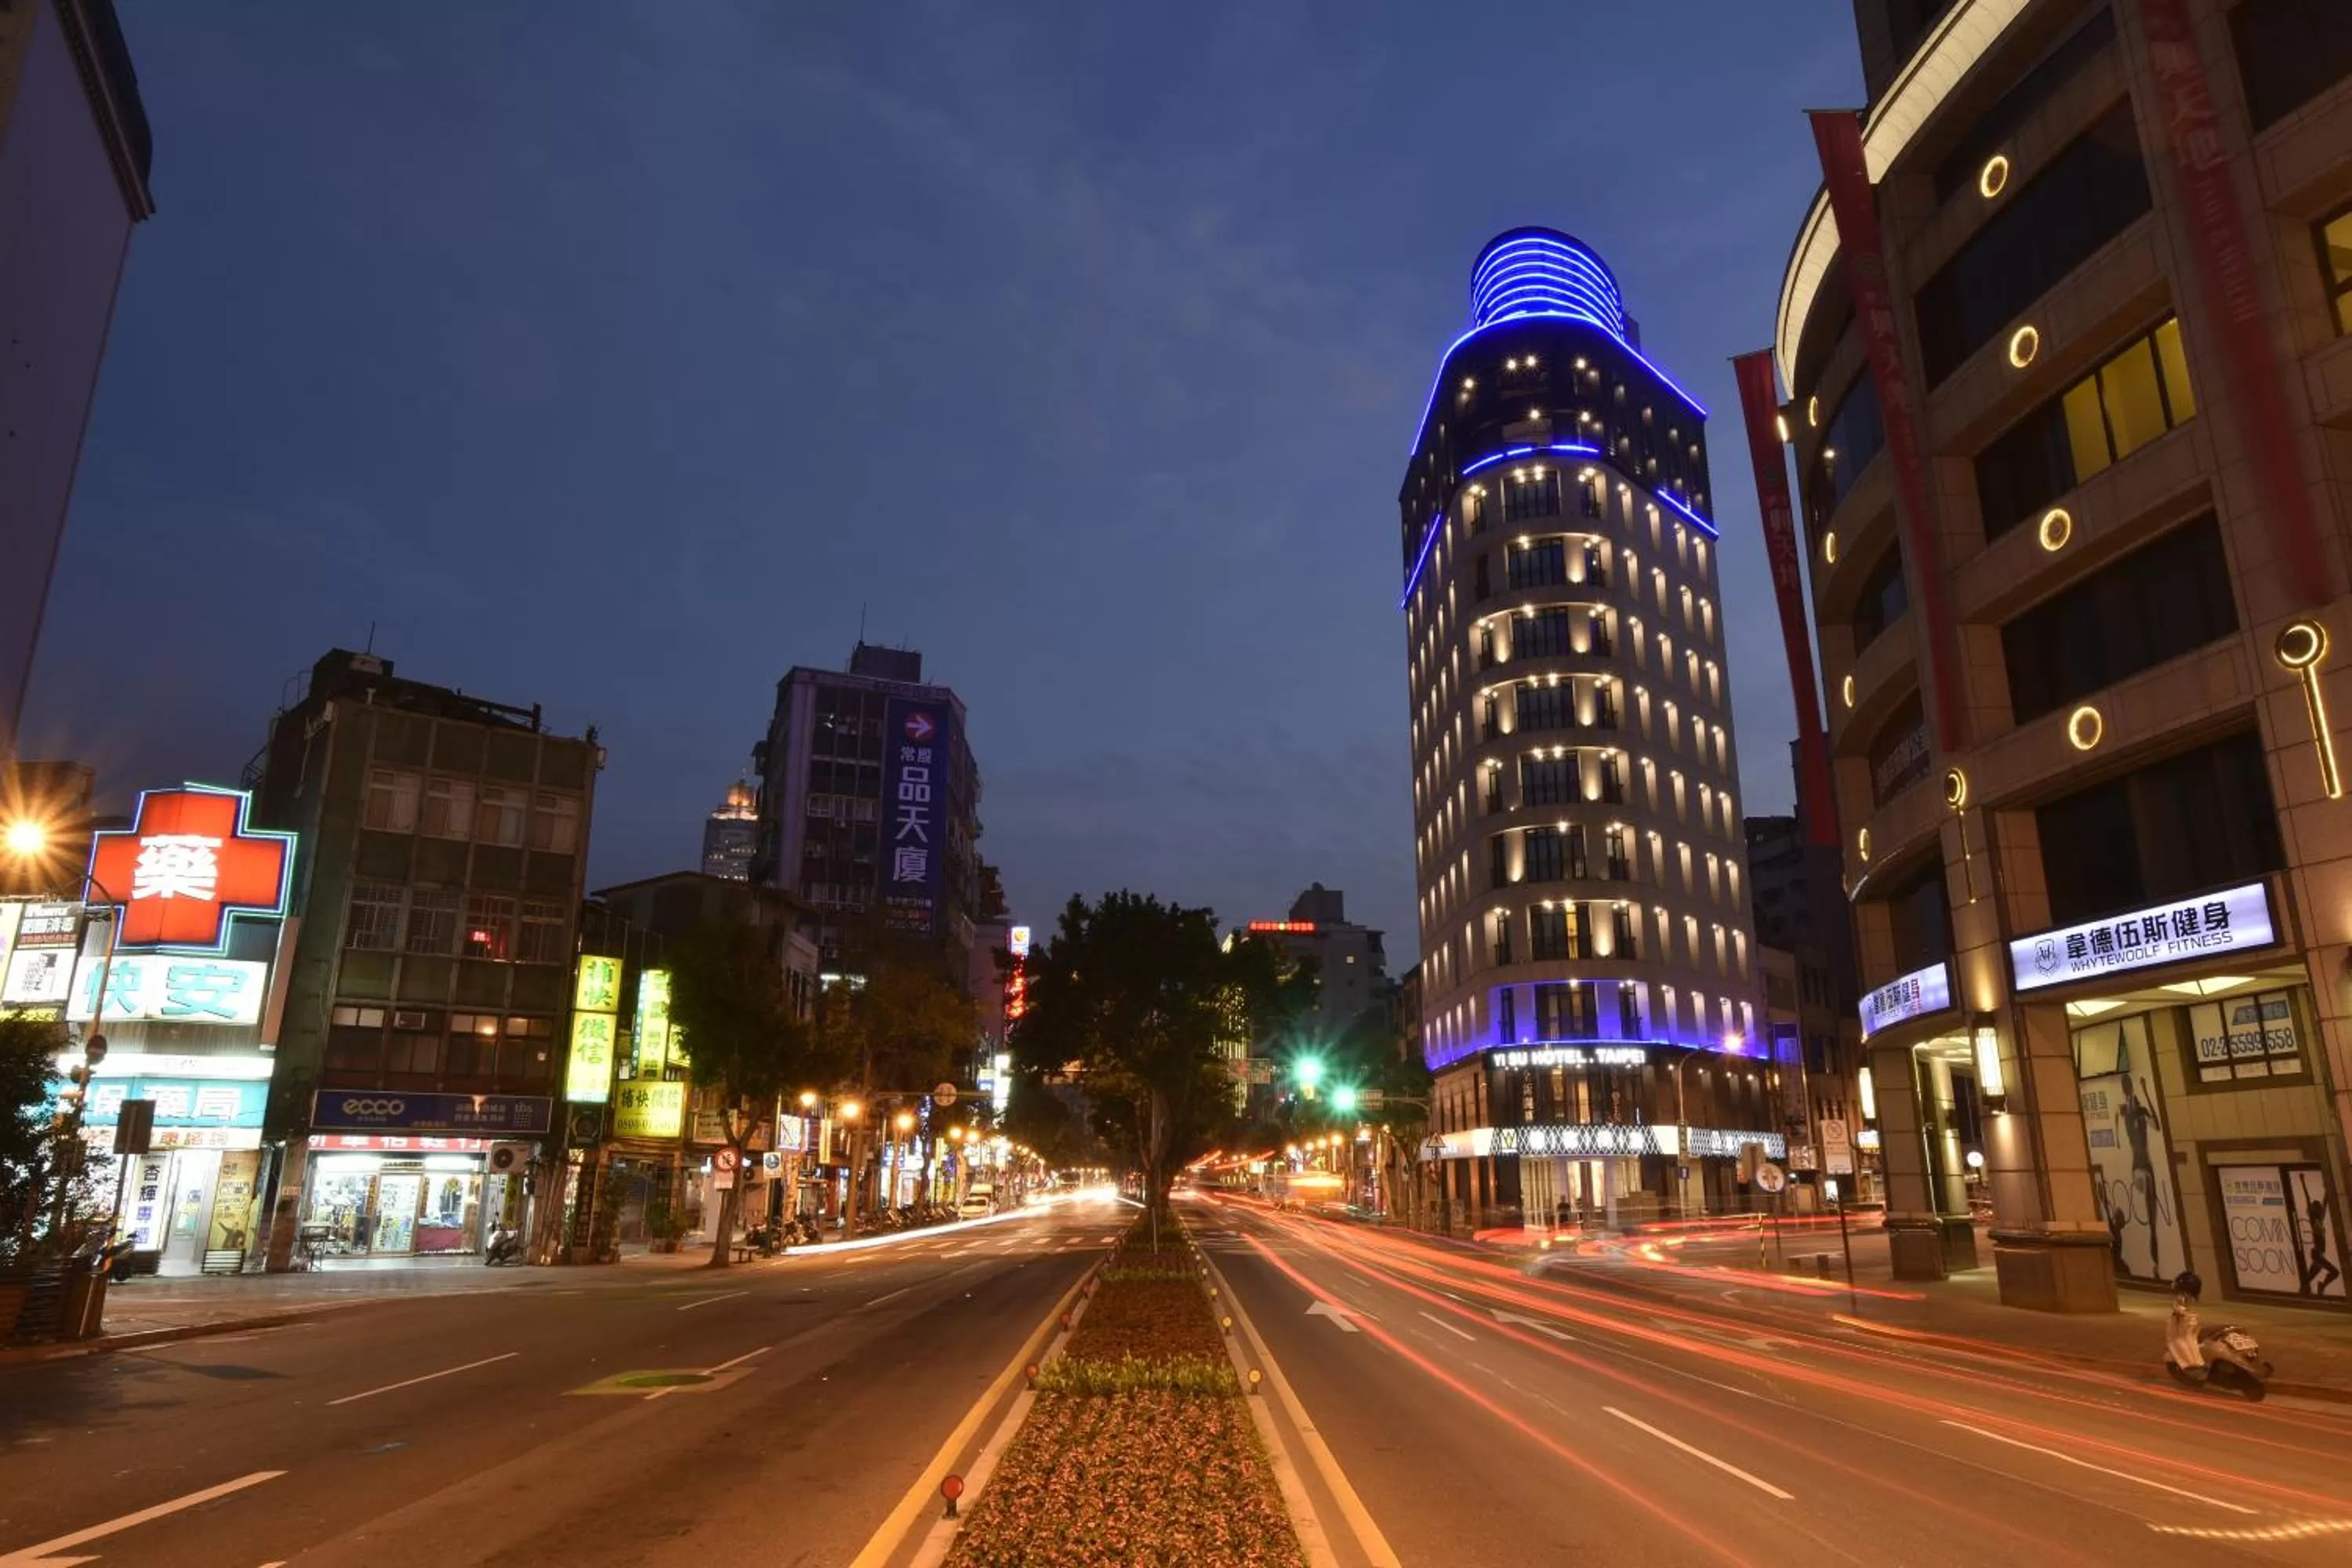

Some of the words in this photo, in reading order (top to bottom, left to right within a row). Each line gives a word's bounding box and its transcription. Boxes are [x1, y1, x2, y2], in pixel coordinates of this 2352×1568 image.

[893, 765, 932, 883] 品天廈
[2065, 901, 2233, 960] 韋德伍斯健身
[2071, 944, 2161, 973] WHYTEWOOLF
[2168, 931, 2234, 954] FITNESS
[83, 961, 249, 1020] 快安
[1508, 1051, 1528, 1066] SU
[1531, 1049, 1588, 1066] HOTEL
[1595, 1047, 1646, 1064] TAIPEI
[341, 1098, 406, 1116] ecco
[2235, 1247, 2296, 1275] SOON
